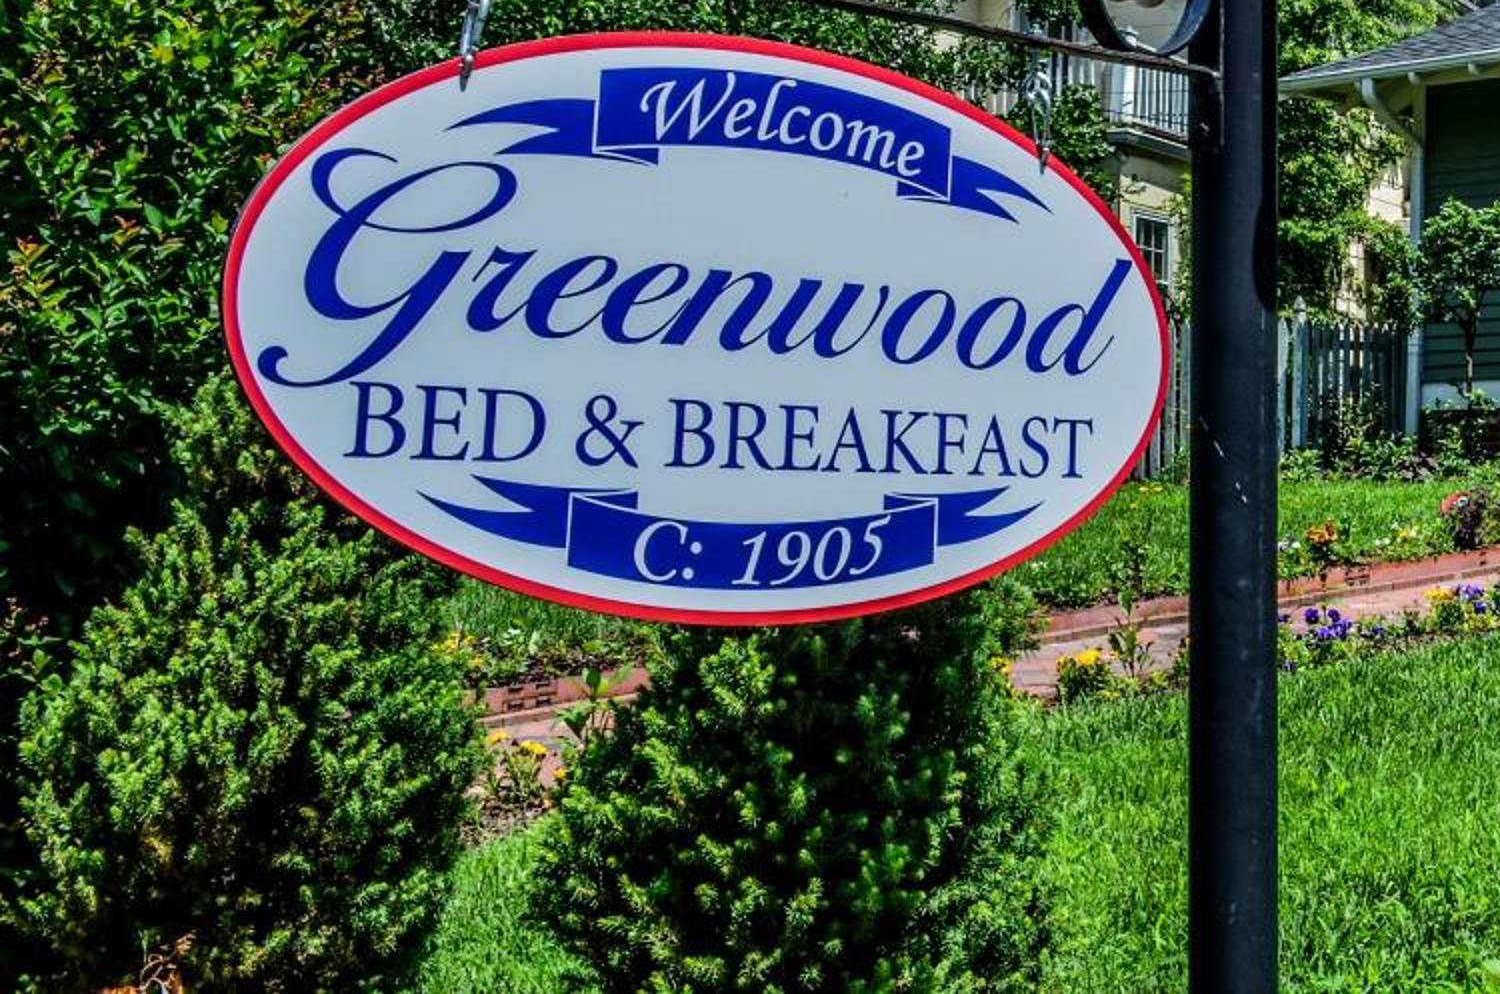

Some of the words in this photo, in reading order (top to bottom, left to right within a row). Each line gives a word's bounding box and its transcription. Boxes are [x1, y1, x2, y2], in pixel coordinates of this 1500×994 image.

[640, 72, 926, 178] Welcome
[257, 146, 1132, 388] Greenwood
[343, 379, 546, 463] BED
[575, 394, 644, 469] &
[664, 399, 1094, 480] BREAKFAST
[633, 521, 702, 585] C:
[731, 515, 892, 587] 1905
